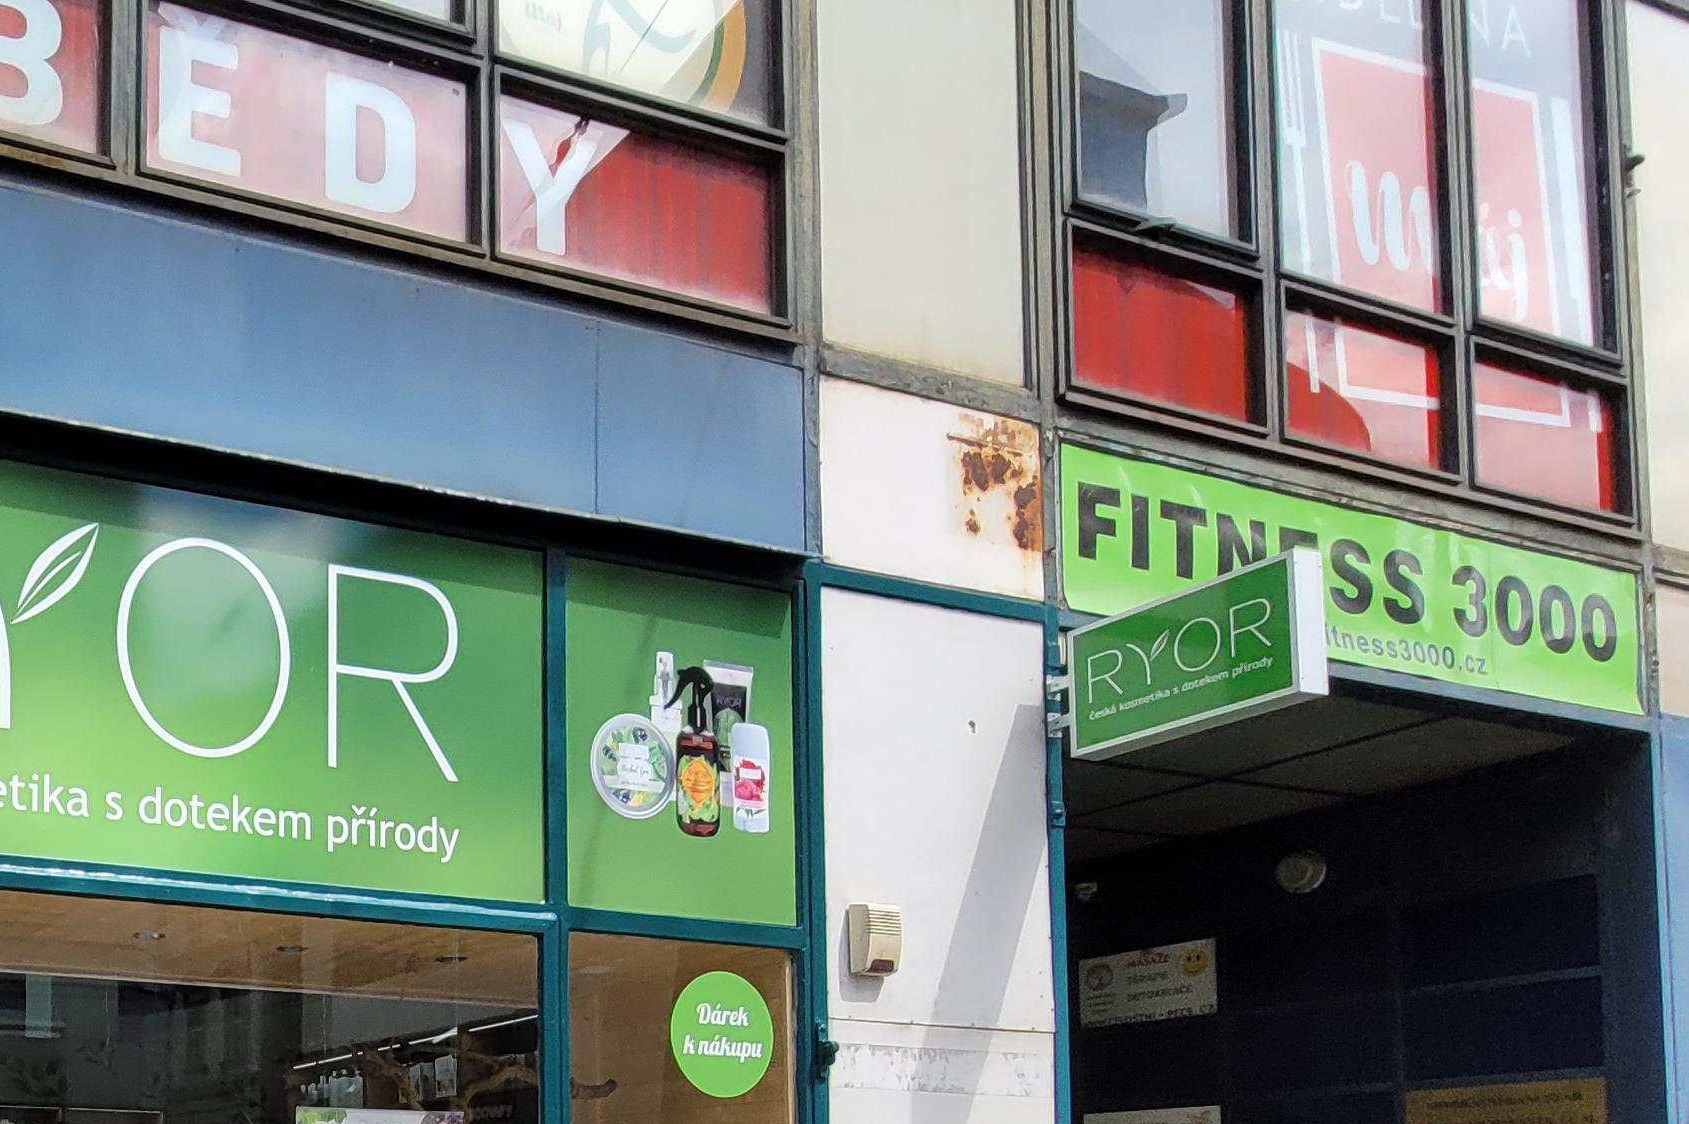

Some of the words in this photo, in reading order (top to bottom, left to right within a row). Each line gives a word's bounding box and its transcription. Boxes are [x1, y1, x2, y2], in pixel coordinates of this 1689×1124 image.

[1077, 481, 1425, 624] FITNSS
[1452, 565, 1617, 663] 3000
[1087, 598, 1272, 704] RYOR
[1325, 623, 1489, 676] itness3000.cz
[106, 794, 123, 821] s
[139, 786, 311, 842] dotekem
[326, 806, 459, 863] přírody
[696, 1000, 749, 1027] Dárek
[683, 1034, 695, 1055] k
[697, 1036, 763, 1060] nákupu
